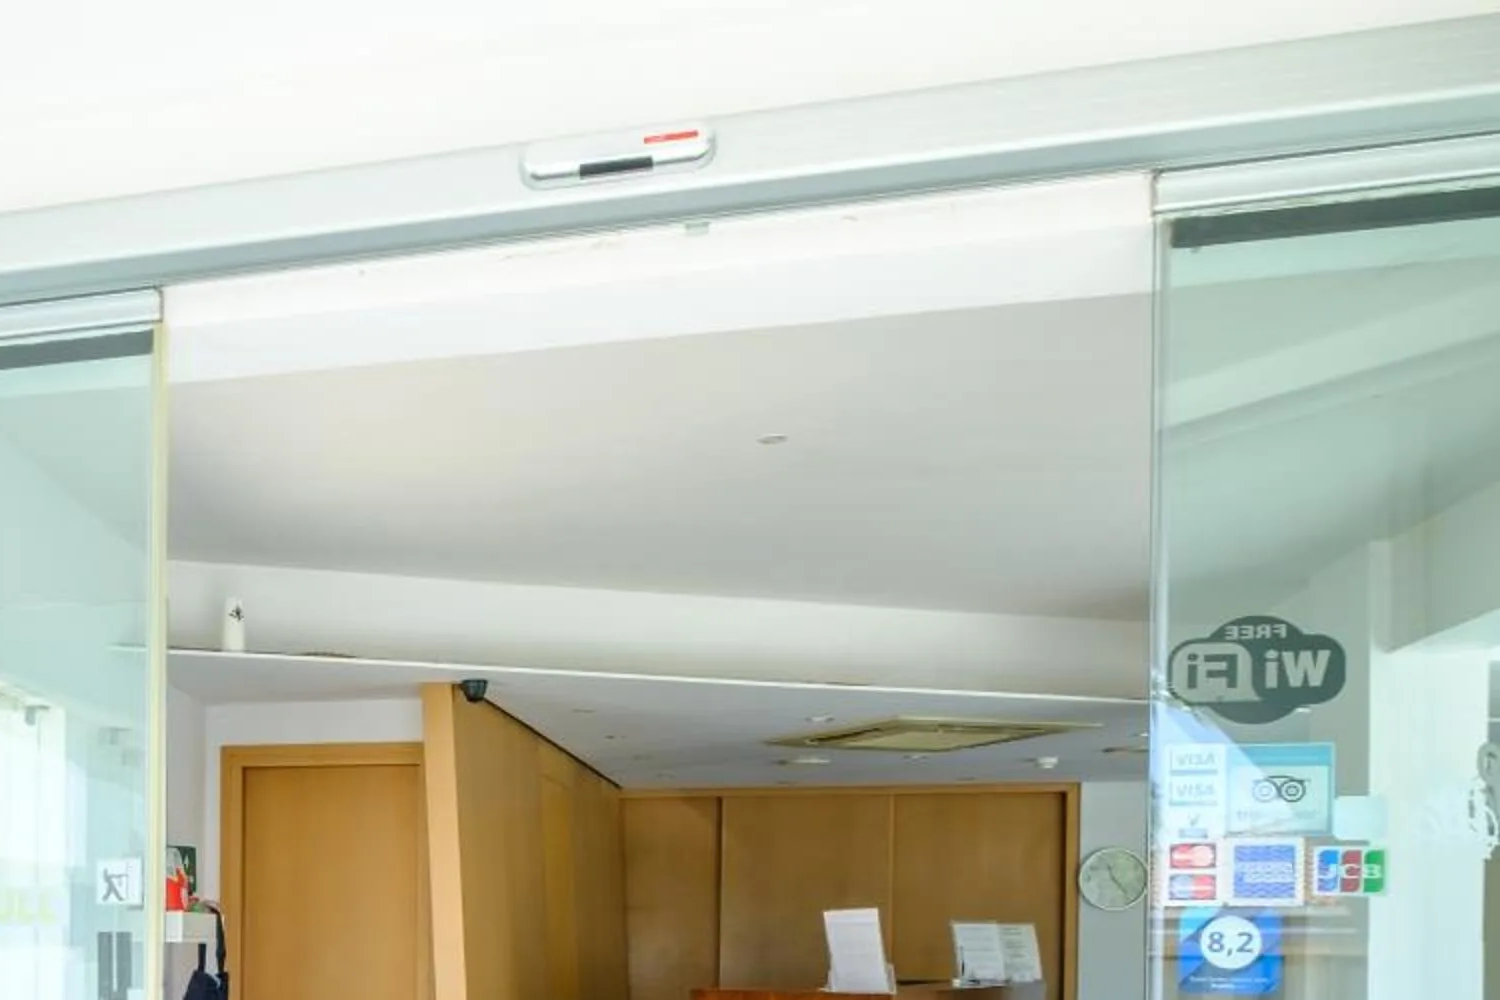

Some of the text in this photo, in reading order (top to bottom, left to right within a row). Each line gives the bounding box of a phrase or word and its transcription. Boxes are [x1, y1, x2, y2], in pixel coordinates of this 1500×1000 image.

[1176, 752, 1216, 766] VISA
[1175, 783, 1215, 797] VISA
[1319, 863, 1382, 879] JCB
[1207, 931, 1255, 957] 8,2
